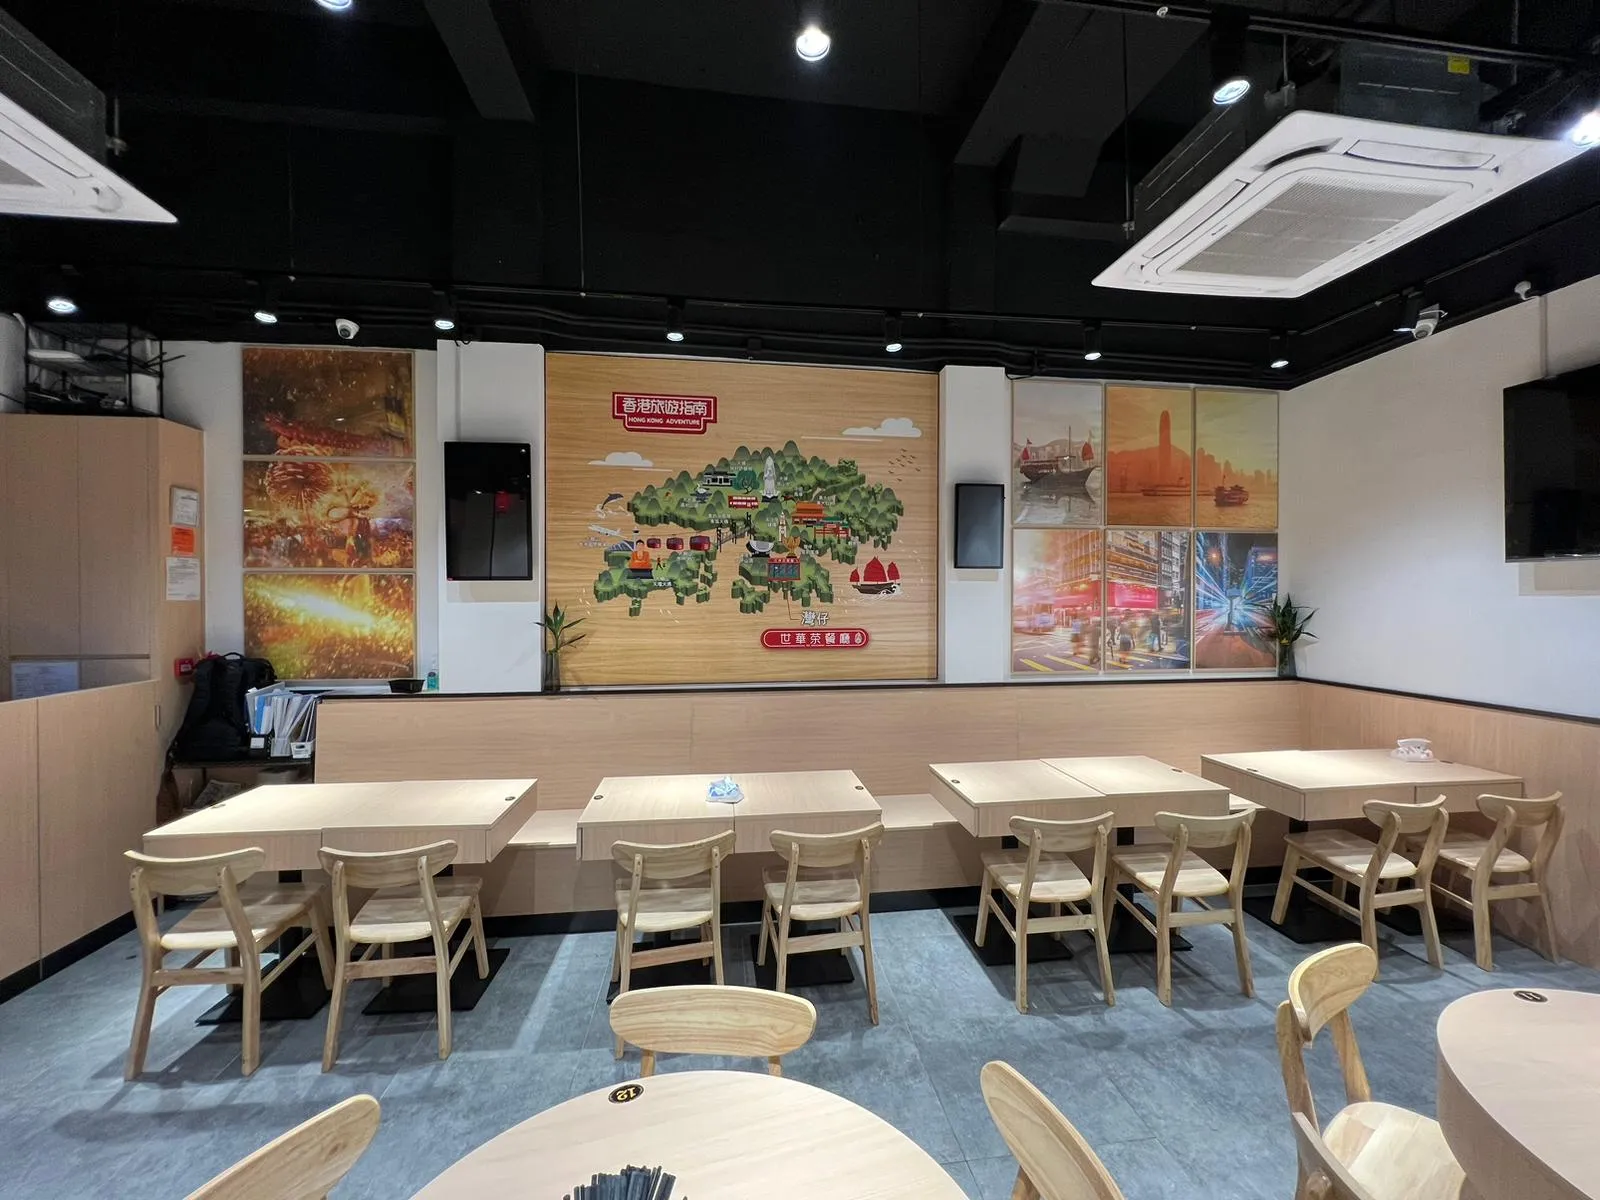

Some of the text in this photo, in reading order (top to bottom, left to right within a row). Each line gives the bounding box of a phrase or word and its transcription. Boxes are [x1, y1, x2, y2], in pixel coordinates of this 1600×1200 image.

[622, 398, 707, 416] 香港旅遊指南
[665, 418, 700, 426] ADVENTURE
[801, 610, 829, 626] 灣仔
[616, 1087, 636, 1100] 12
